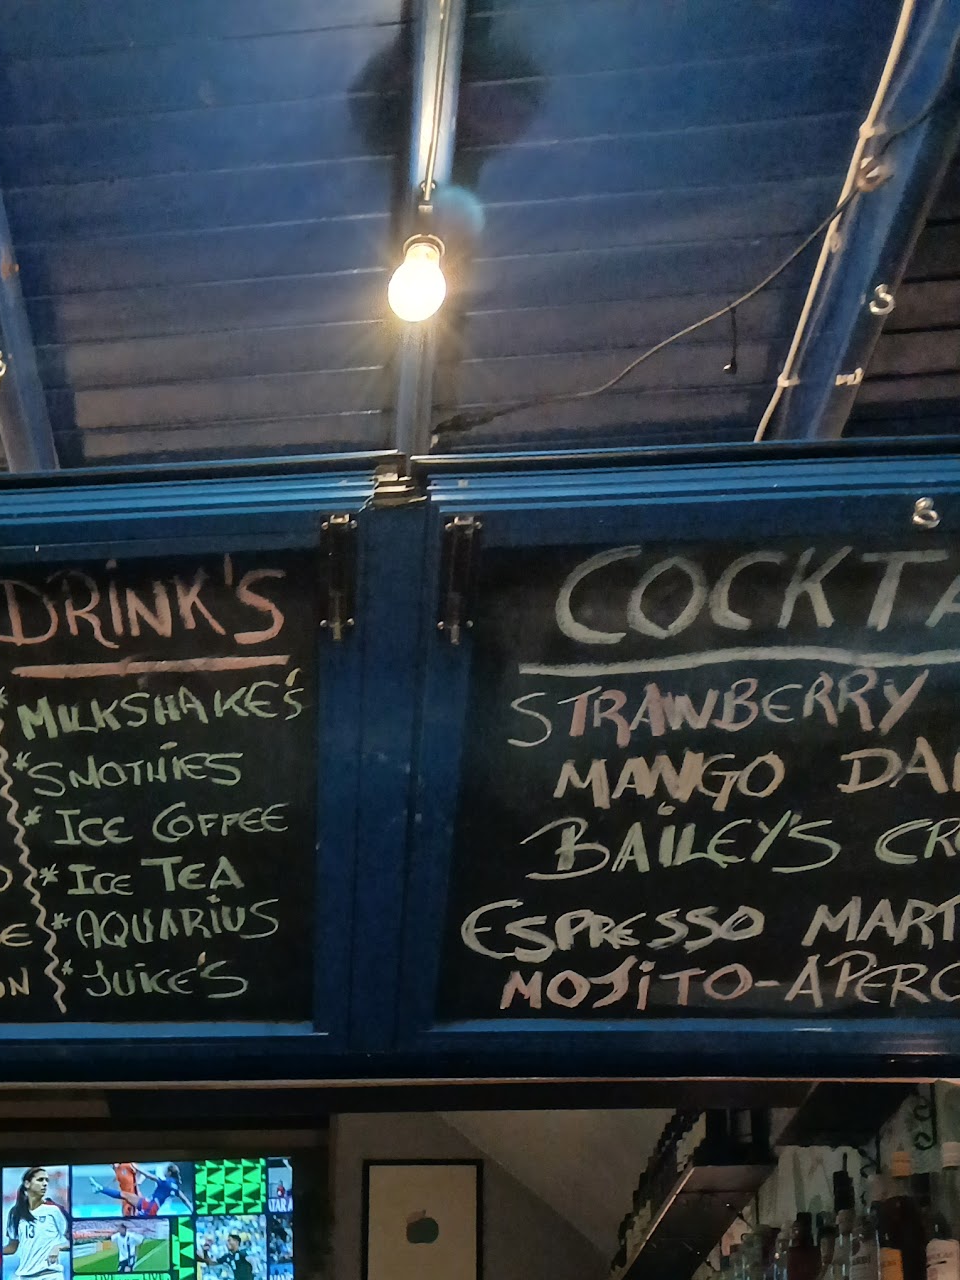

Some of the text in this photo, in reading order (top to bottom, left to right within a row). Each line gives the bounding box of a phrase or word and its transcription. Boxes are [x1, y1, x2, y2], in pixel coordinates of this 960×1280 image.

[553, 737, 960, 811] MANGO DA
[54, 808, 133, 846] ICE
[874, 818, 960, 864] CR
[67, 856, 245, 895] ICE TEA
[76, 895, 279, 948] AQUARIUS
[461, 898, 765, 963] ESPRESSO
